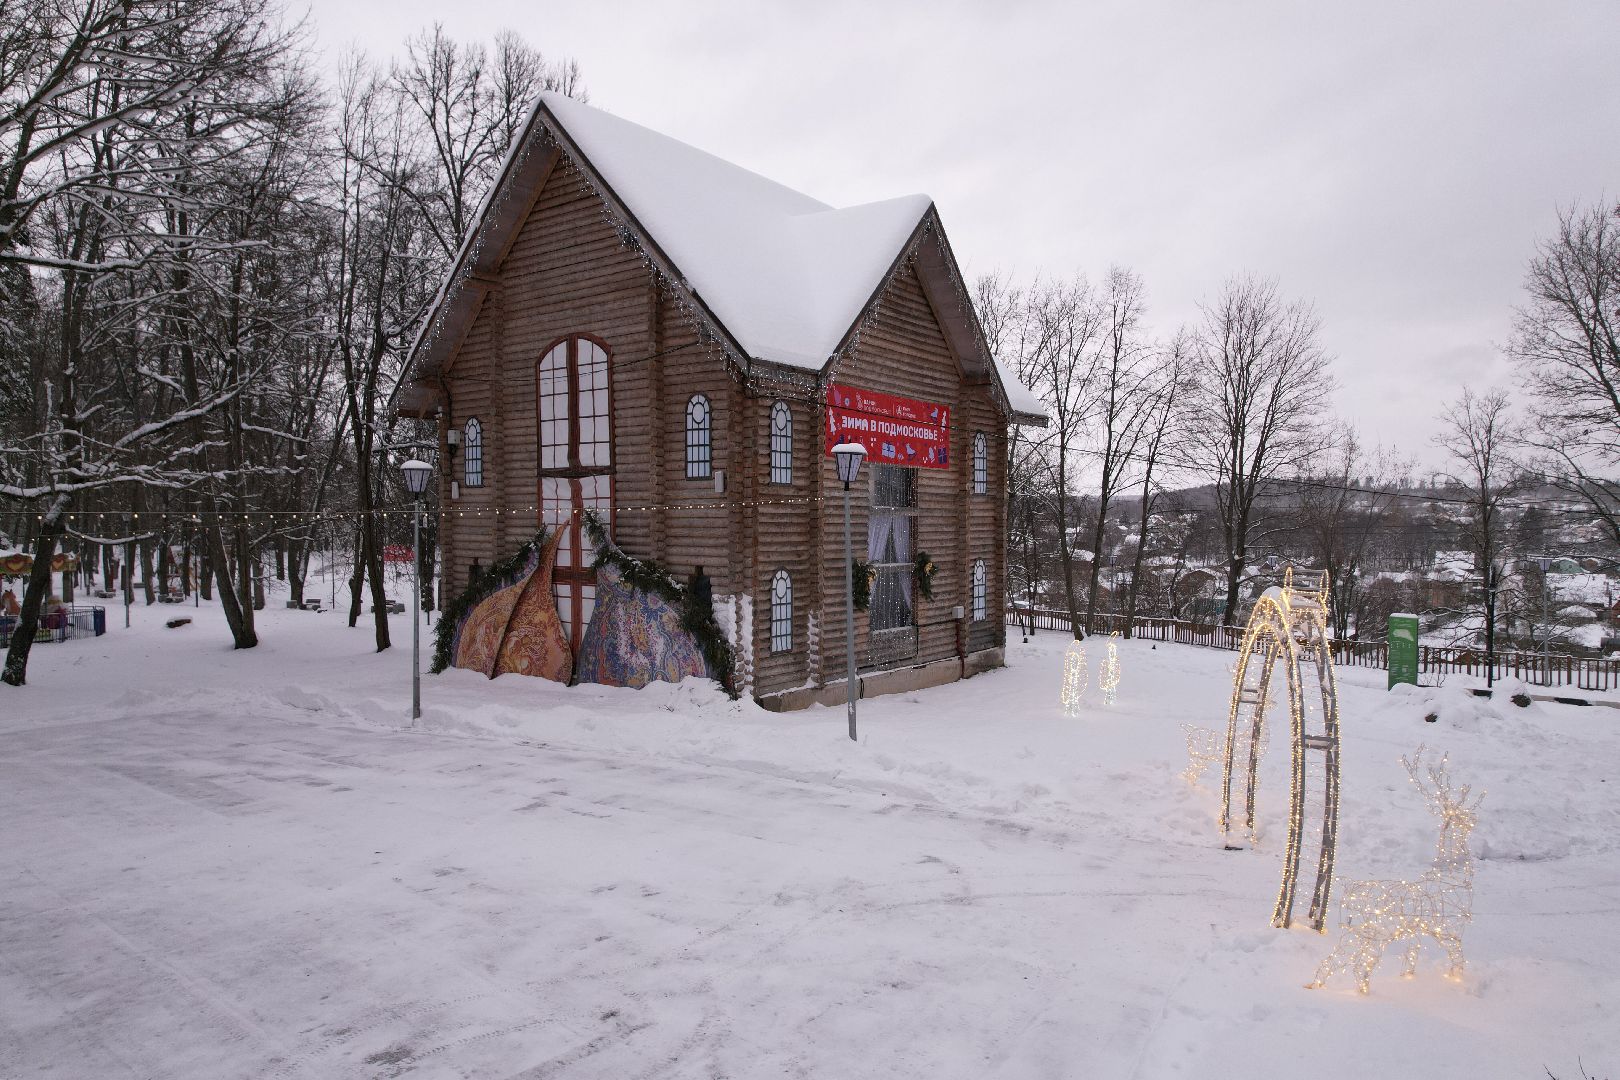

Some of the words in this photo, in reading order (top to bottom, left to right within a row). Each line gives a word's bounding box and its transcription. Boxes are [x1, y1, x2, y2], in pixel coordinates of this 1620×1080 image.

[841, 415, 869, 432] ЗИМА
[870, 419, 877, 432] В
[878, 421, 938, 441] ПОДМОСКОВЬЕ
